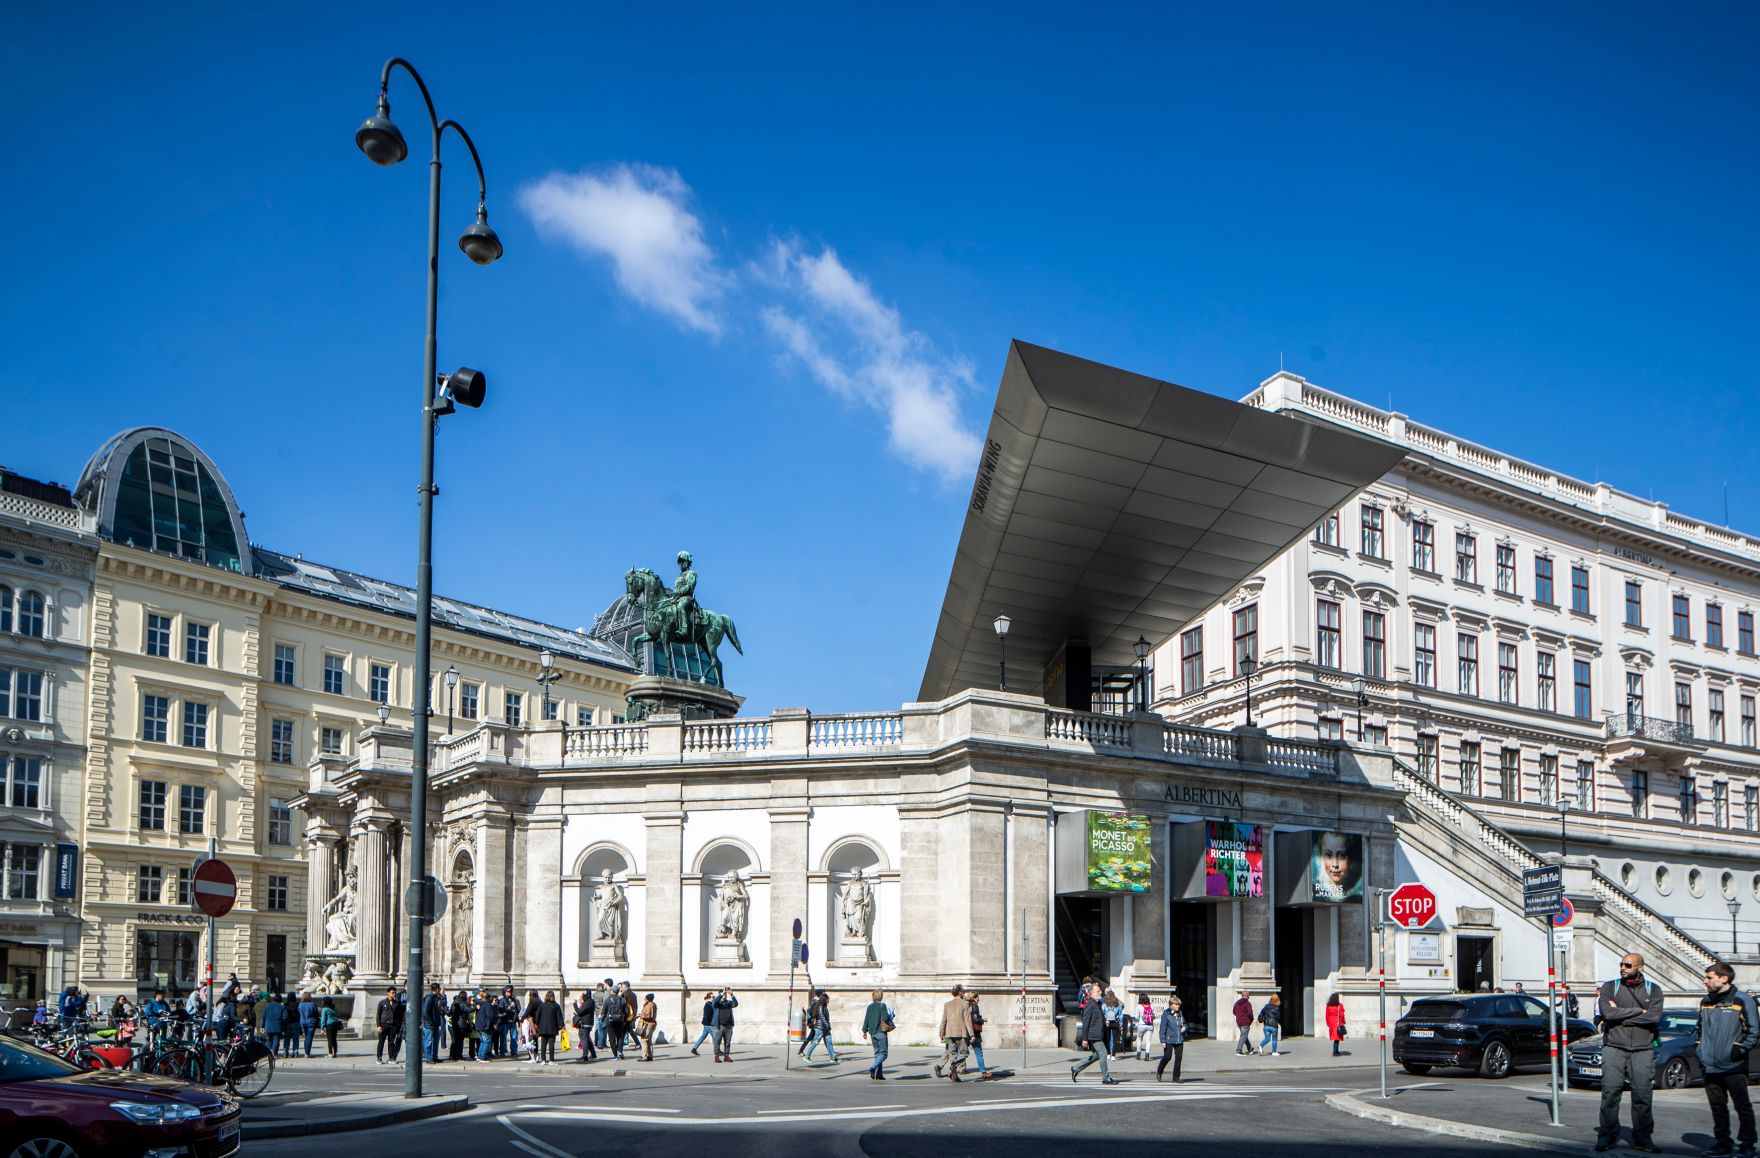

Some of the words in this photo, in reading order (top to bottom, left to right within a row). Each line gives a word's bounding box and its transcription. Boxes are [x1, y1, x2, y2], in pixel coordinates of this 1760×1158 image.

[1164, 783, 1242, 808] ALBERTINA
[1092, 829, 1127, 841] MONET
[1092, 839, 1135, 852] PICASSO
[1210, 839, 1247, 851] WARHOL
[1210, 848, 1246, 860] RICHTER
[1315, 883, 1344, 893] RUBENS
[1394, 897, 1433, 915] STOP
[137, 912, 172, 923] FRACK
[175, 914, 183, 923] &
[186, 914, 204, 925] CO
